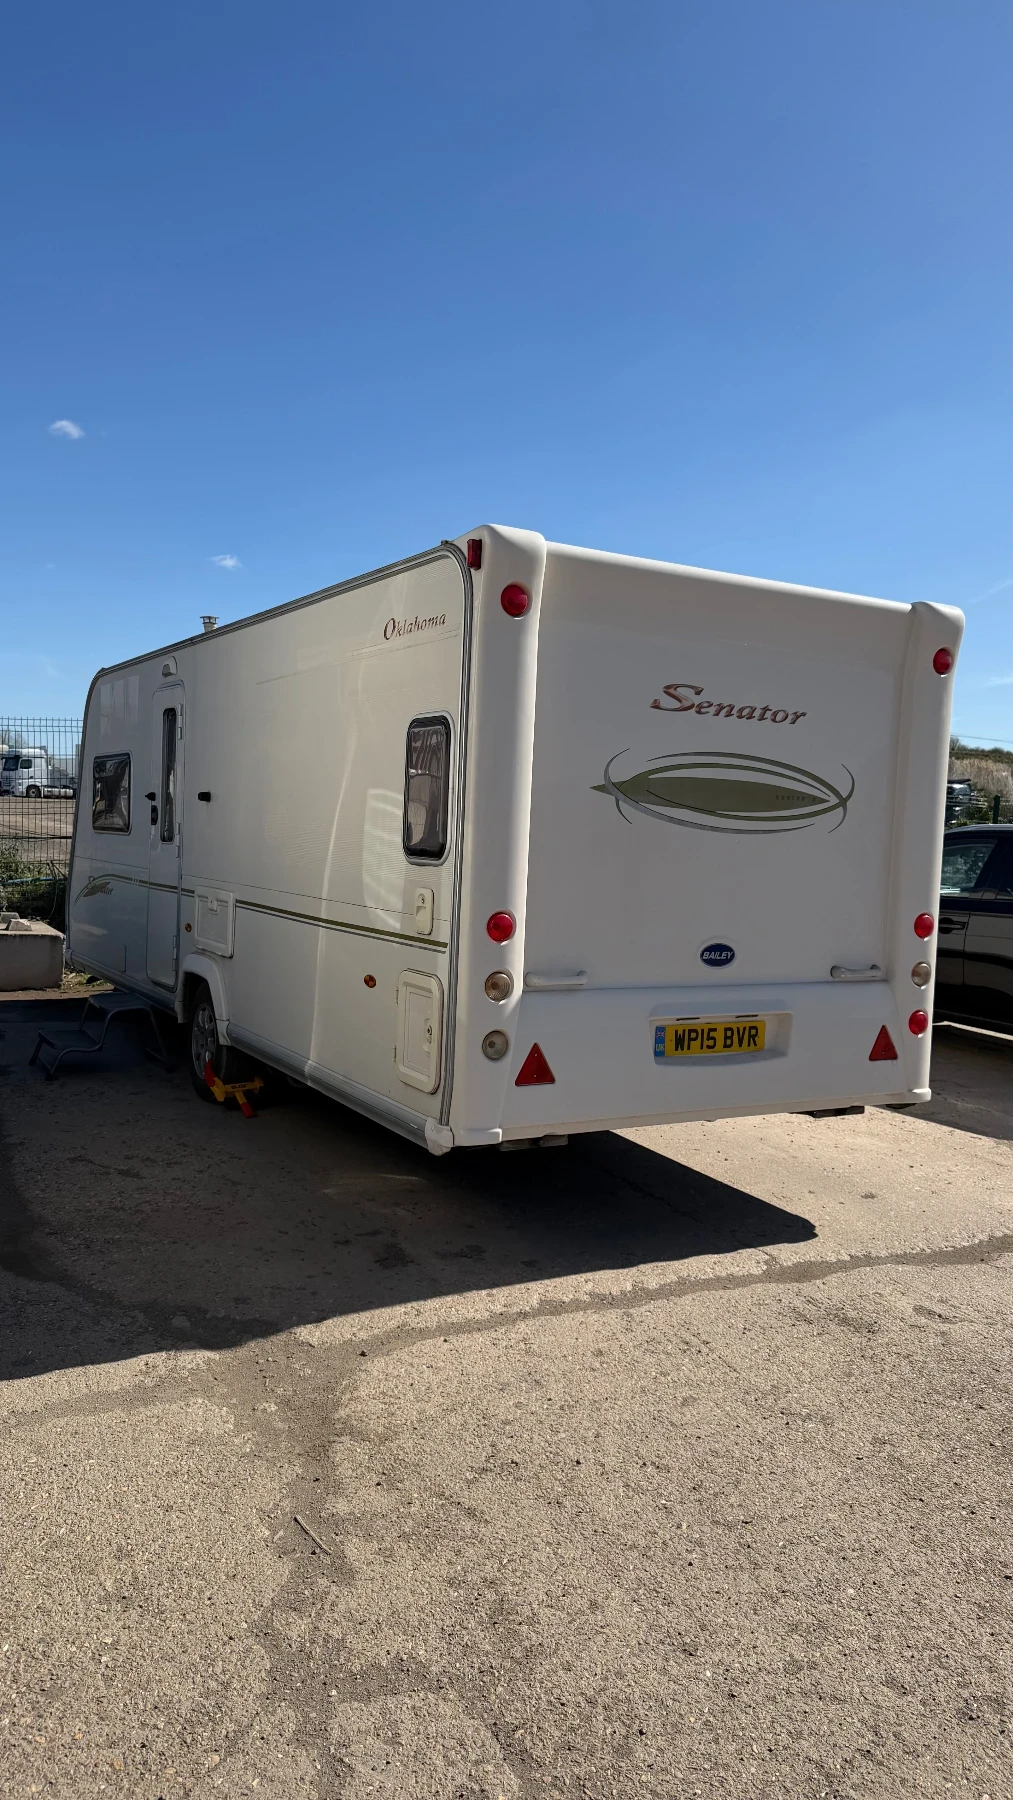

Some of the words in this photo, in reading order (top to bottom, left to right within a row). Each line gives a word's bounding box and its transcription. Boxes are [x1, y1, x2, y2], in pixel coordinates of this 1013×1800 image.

[384, 613, 447, 640] Oklahoma
[650, 683, 807, 724] Senator
[702, 951, 734, 960] BAILEY
[656, 1043, 665, 1052] UK
[674, 1027, 718, 1052] WP15
[723, 1025, 759, 1049] BVR
